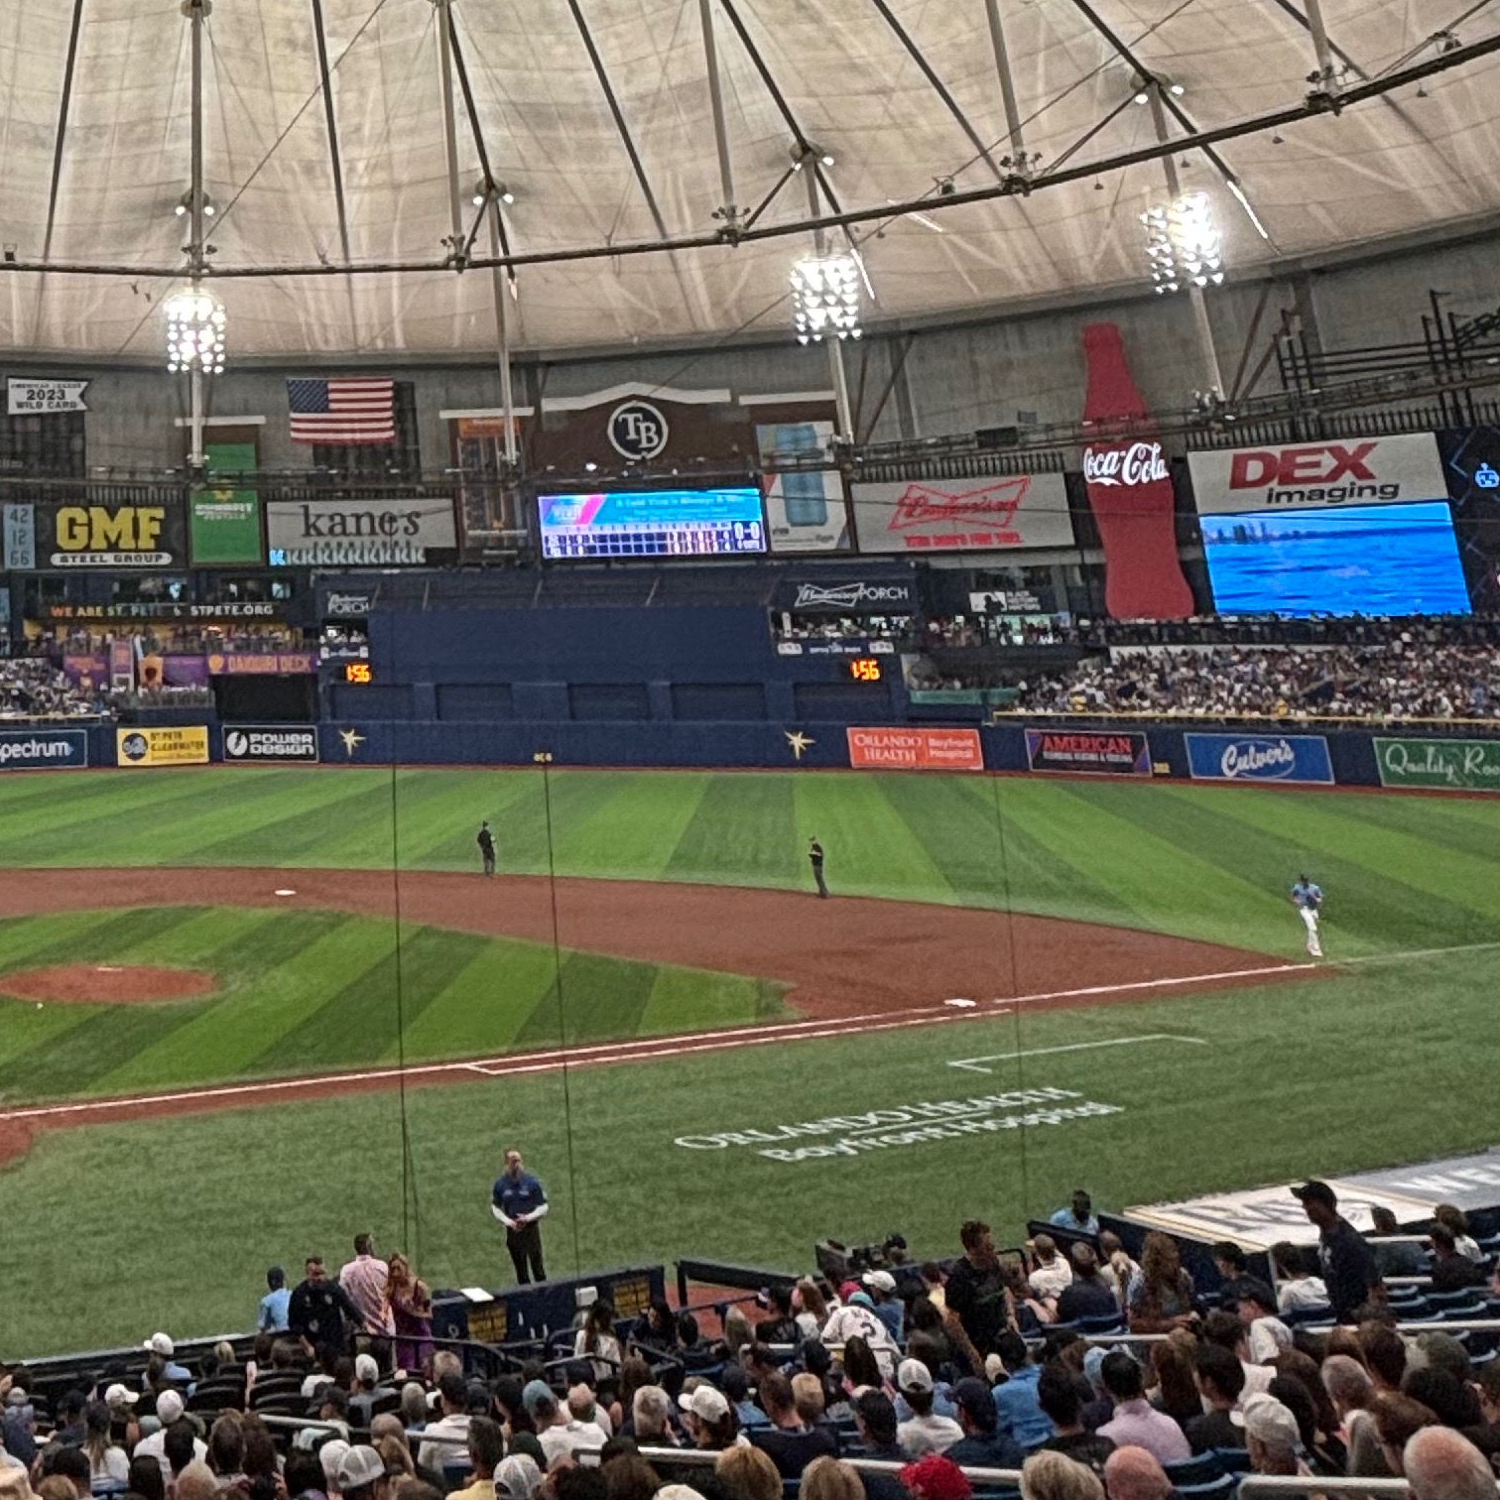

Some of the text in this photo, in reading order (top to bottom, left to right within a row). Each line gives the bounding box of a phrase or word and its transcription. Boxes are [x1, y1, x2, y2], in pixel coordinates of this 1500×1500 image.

[26, 389, 67, 401] 2023
[16, 400, 78, 410] WILD CARD
[618, 413, 658, 449] TB
[1084, 442, 1170, 485] Coca-Cola
[1229, 442, 1379, 490] DEX
[1266, 482, 1400, 504] imaging
[9, 508, 29, 523] 42
[56, 506, 165, 550] GMF
[12, 530, 27, 545] 12
[59, 553, 163, 564] STEEL GROUP
[860, 586, 908, 600] PORCH
[51, 605, 73, 617] WE
[76, 605, 103, 617] ARE
[190, 605, 274, 616] STPETE.ORG
[250, 733, 314, 744] POWER
[854, 734, 922, 747] ORLANDO
[1042, 736, 1131, 753] AMERICAN
[250, 744, 314, 755] DESIGN
[864, 748, 916, 761] HEALTH
[1385, 743, 1455, 781] Quality
